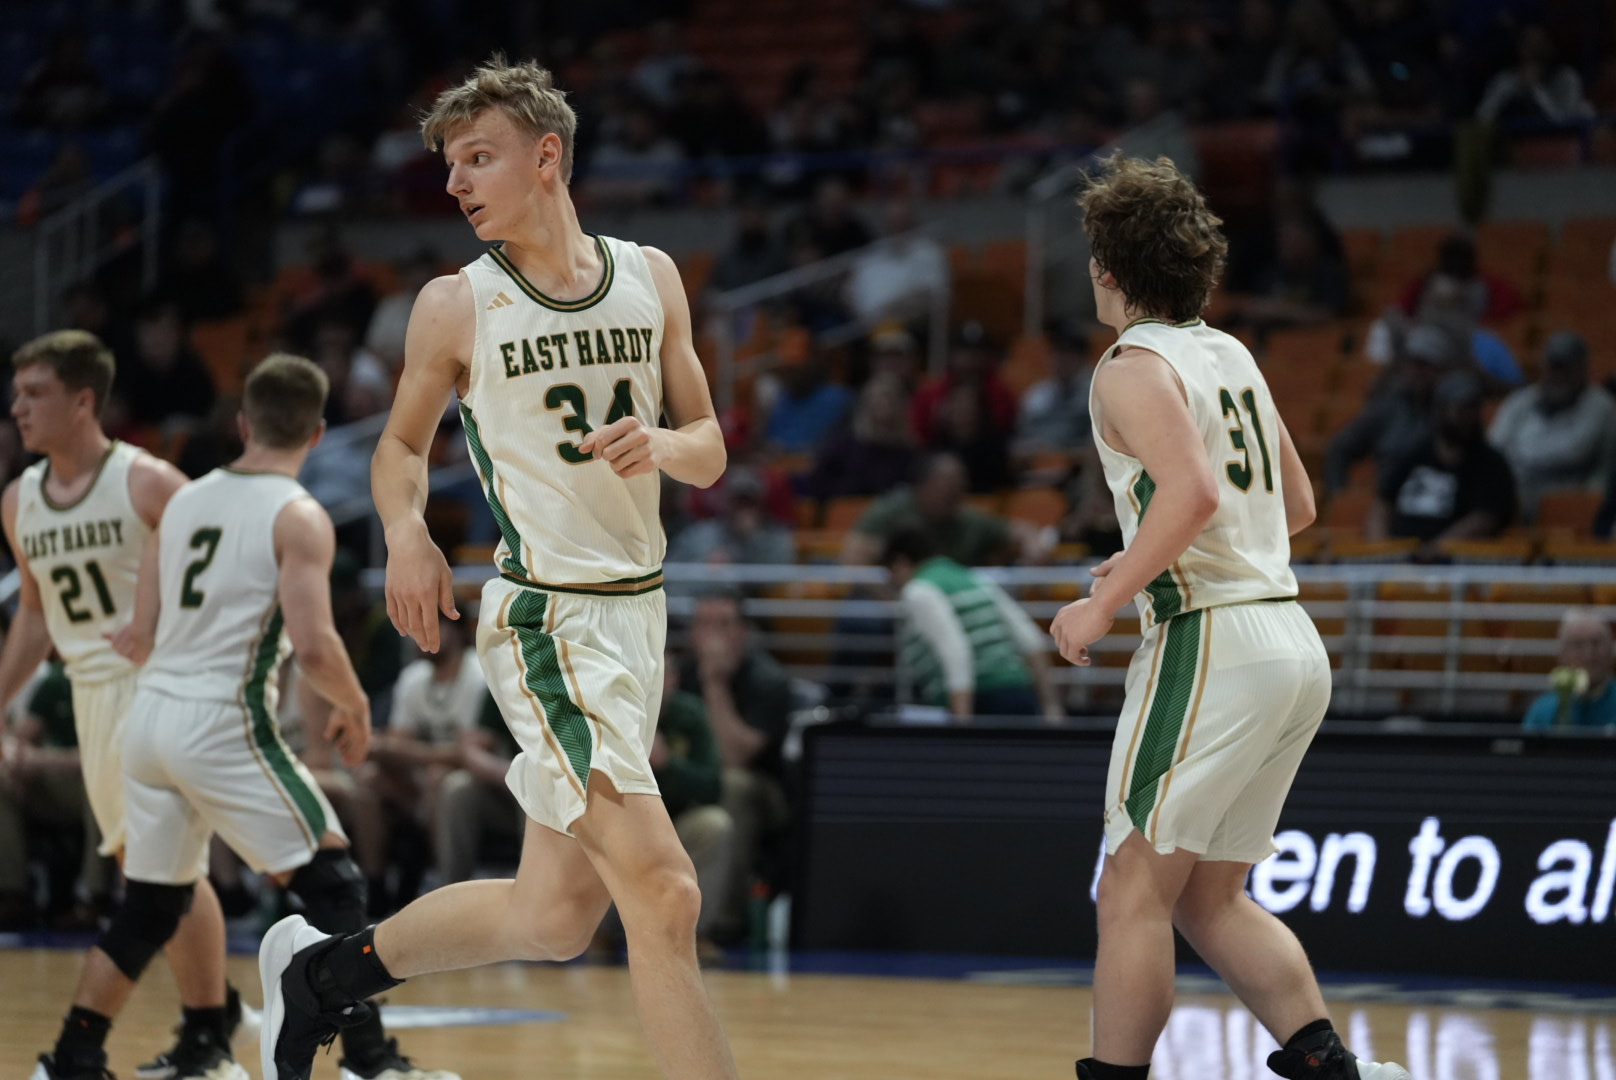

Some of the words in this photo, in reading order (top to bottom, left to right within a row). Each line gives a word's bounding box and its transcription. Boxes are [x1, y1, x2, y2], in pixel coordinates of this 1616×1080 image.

[499, 332, 569, 379] EAST
[573, 327, 653, 366] HARDY
[543, 377, 635, 466] 34
[1217, 386, 1274, 495] 31
[62, 518, 122, 552] HARDY
[179, 526, 223, 608] 2
[51, 559, 117, 624] 21
[1403, 817, 1500, 921] to
